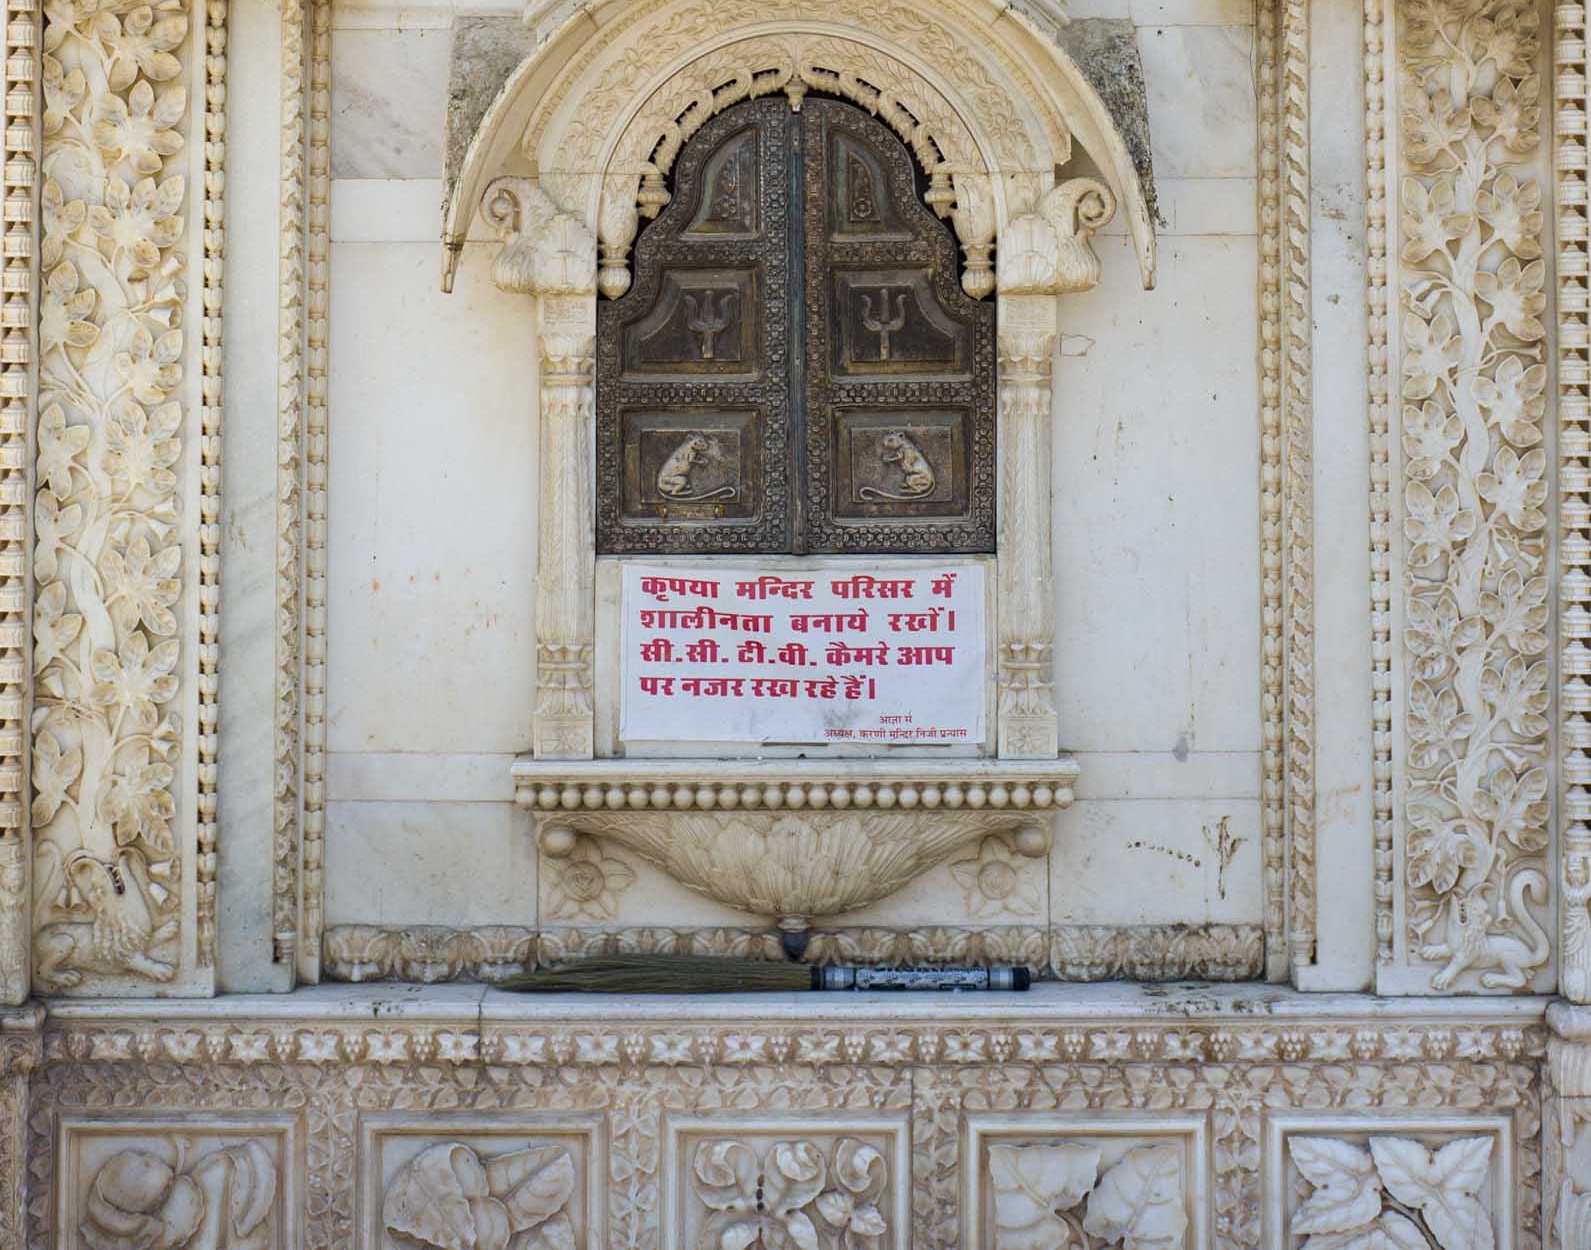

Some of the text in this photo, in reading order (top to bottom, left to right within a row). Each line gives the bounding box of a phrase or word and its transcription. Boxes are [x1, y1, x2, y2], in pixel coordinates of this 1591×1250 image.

[641, 573, 957, 601] कृपया मन्दिर परिसर में
[640, 606, 772, 633] शालीनता
[790, 608, 869, 633] बनाये
[826, 641, 890, 666] कैमरे
[896, 646, 954, 666] आप
[639, 676, 676, 697] पर
[681, 677, 746, 697] नजर
[751, 677, 799, 698] रख
[803, 675, 839, 699] रहे
